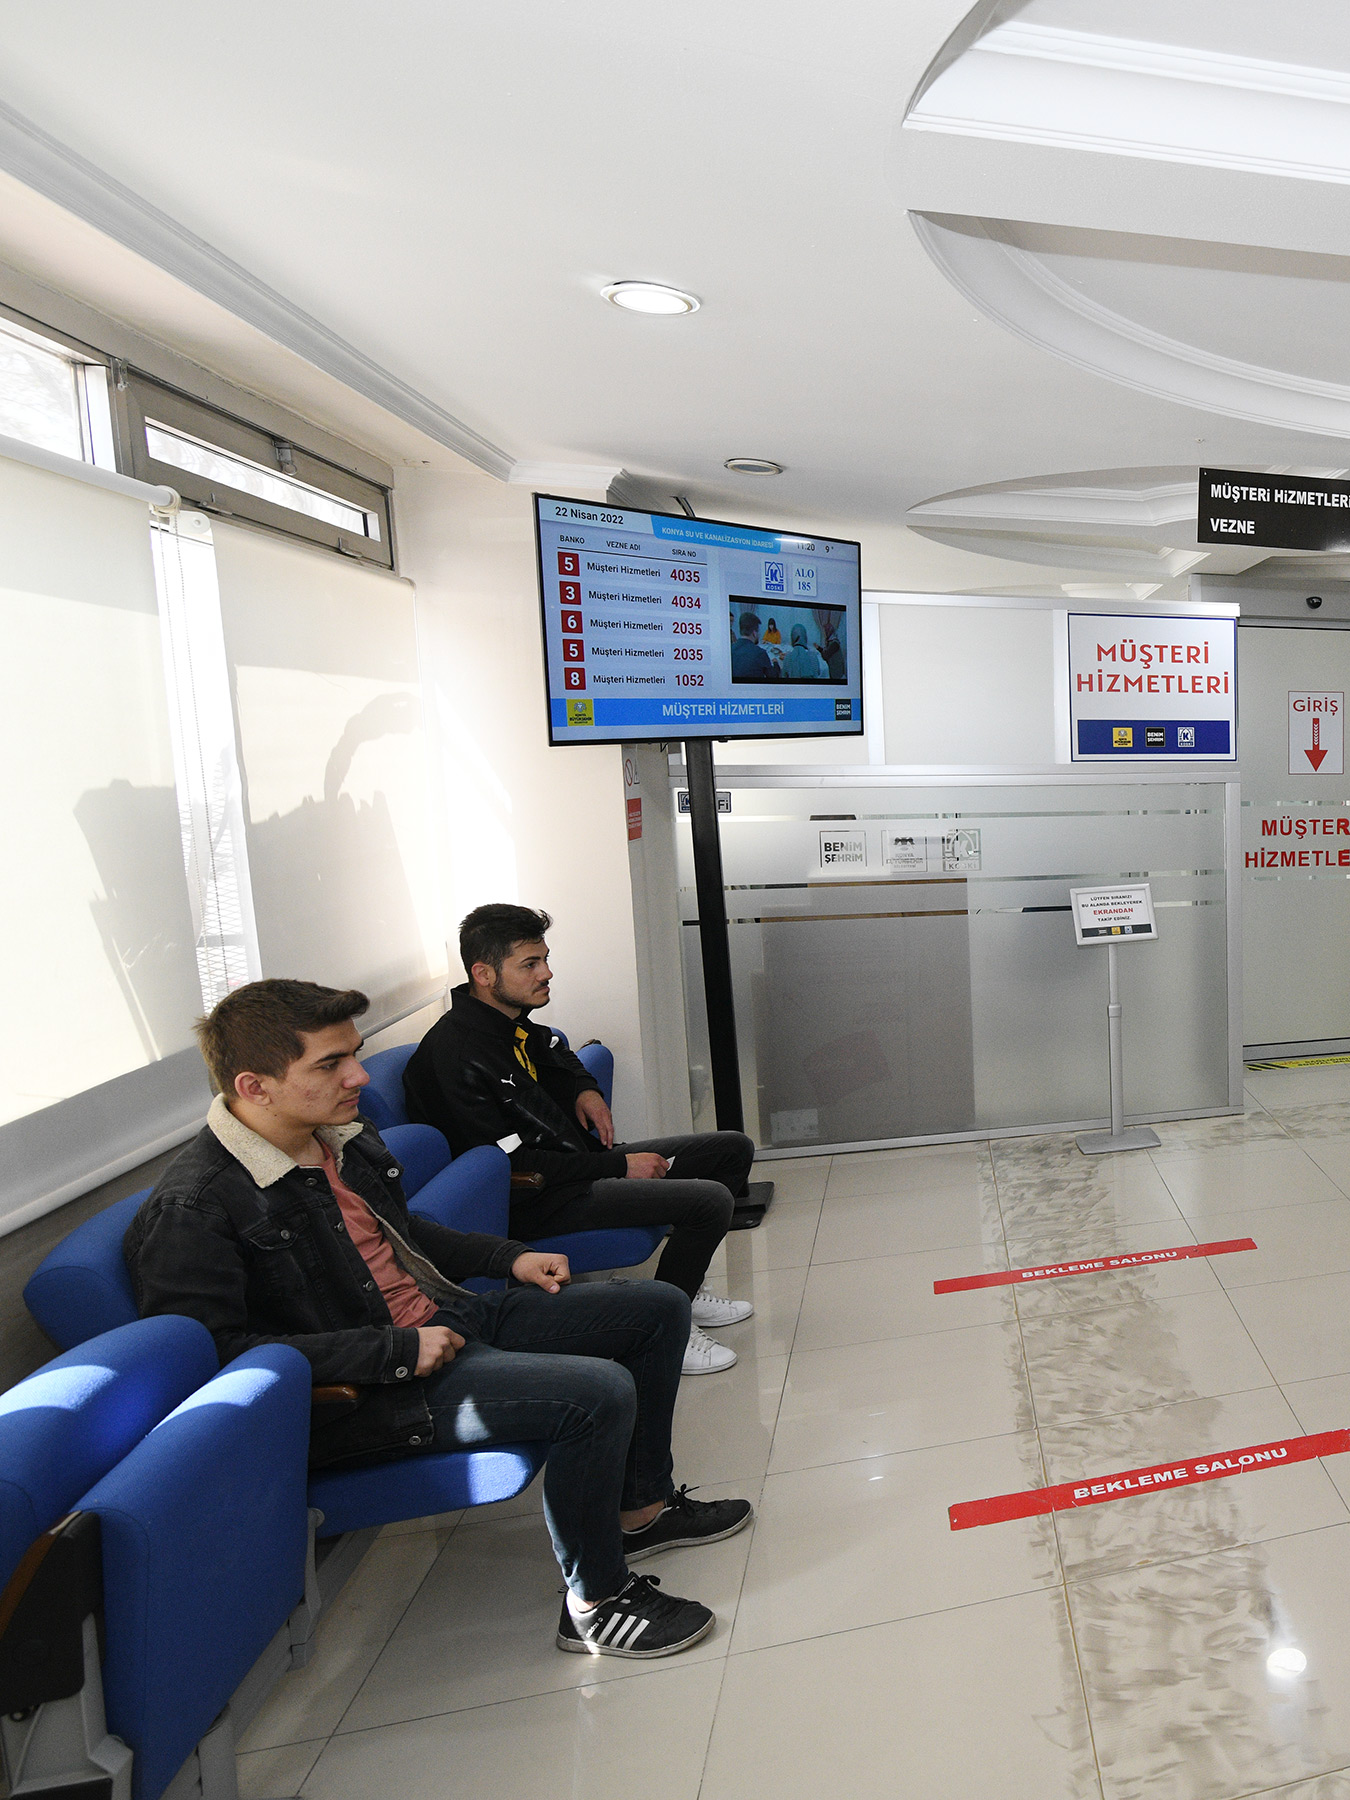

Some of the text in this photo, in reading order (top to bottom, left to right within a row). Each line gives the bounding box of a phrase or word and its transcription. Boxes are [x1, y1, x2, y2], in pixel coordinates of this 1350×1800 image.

[555, 506, 624, 525] 22 Nisan 2022
[1210, 518, 1256, 535] VEZNE
[560, 534, 585, 544] BANKO
[606, 540, 628, 550] VEZNE
[662, 527, 774, 549] KONYA SU VE KANALİZASYON İDARESİ
[672, 548, 696, 558] SIRA NO
[564, 556, 700, 583] 5 Müşteri Hizmetleri 4035
[794, 568, 814, 578] ALO
[798, 581, 812, 592] 185
[565, 585, 702, 609] 3 Müşteri Hizmetleri 4034
[567, 614, 702, 636] 6 Müşteri Hizmetleri 2035
[568, 643, 704, 661] 5 Müşteri Hizmetleri 2035
[1096, 639, 1210, 669] MÜŞTERİ
[570, 672, 704, 687] 8 Müşteri Hizmetleri 1052
[1076, 669, 1229, 694] HİZMETLERİ
[662, 702, 784, 719] MÜŞTERİ HİZMETLERİ
[1292, 697, 1338, 716] GİRİŞ
[1022, 1251, 1178, 1278] BEKLEME SALONU
[1074, 1447, 1288, 1500] BEKLEME SALONU
